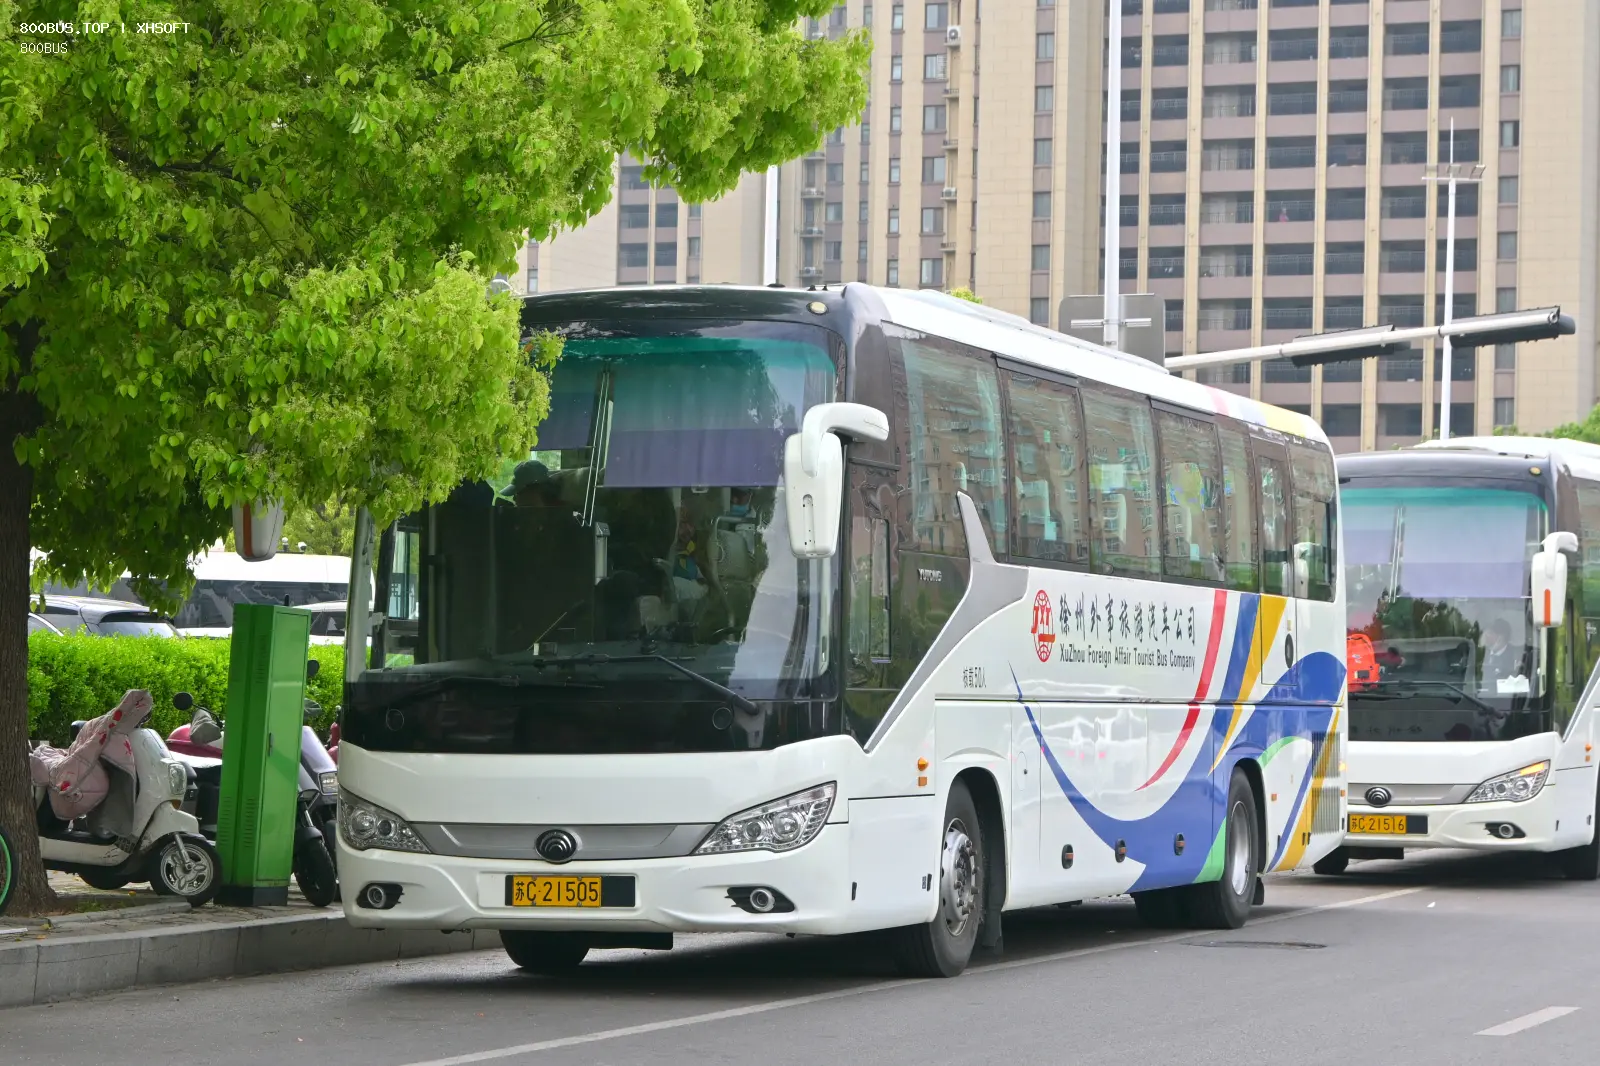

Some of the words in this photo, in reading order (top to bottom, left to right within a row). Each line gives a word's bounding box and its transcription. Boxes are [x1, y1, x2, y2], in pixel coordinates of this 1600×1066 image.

[1060, 644, 1085, 662] XuZhou
[1088, 646, 1112, 668] Foreign
[1115, 647, 1131, 666] Affair
[1133, 647, 1155, 667] Tourist
[1157, 649, 1168, 668] Bus
[1170, 650, 1196, 674] Company
